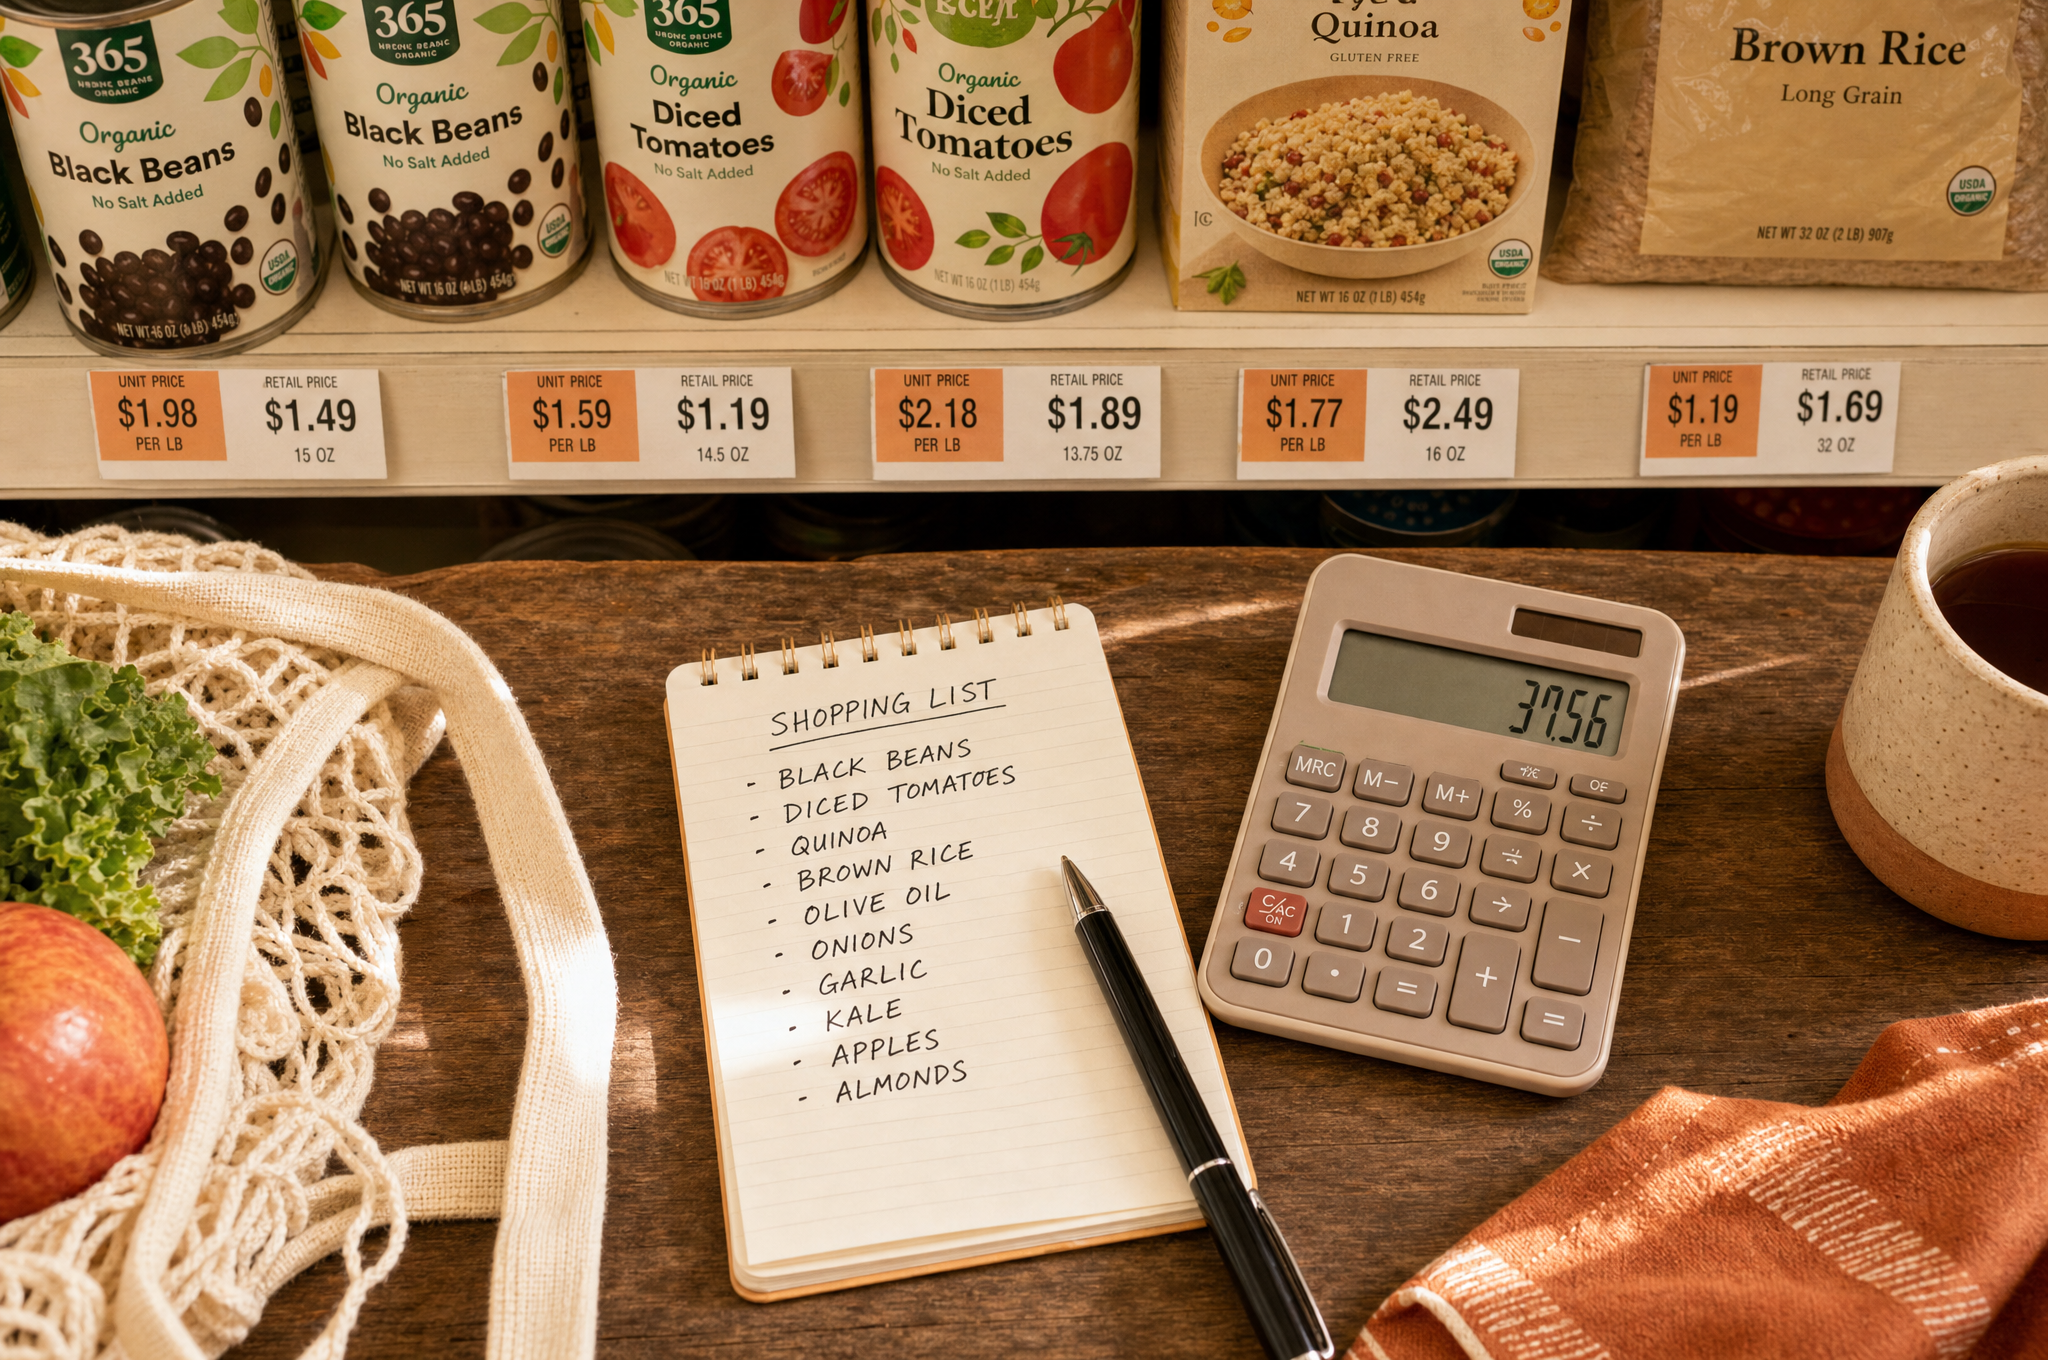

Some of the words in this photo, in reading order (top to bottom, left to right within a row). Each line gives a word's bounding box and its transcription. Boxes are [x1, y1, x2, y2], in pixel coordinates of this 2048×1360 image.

[374, 1, 446, 38] 365
[653, 0, 721, 28] 365
[1311, 12, 1439, 44] Quinoa
[70, 35, 148, 76] 365
[395, 50, 437, 60] ORGANIC
[1330, 53, 1382, 62] GLUTEN
[1387, 53, 1420, 62] FREE
[1730, 27, 1867, 65] Brown
[1879, 30, 1967, 66] Rice
[650, 64, 738, 97] Organic
[938, 62, 1021, 94] Organic
[94, 87, 139, 97] ORGANIC
[376, 82, 469, 114] Organic
[1780, 84, 1836, 108] Long
[1843, 85, 1903, 105] Grain
[653, 99, 741, 128] Diced
[926, 87, 1032, 126] Diced
[344, 110, 424, 145] Black
[432, 105, 523, 144] Beans
[895, 107, 1073, 160] Tomatoes
[79, 121, 176, 153] Organic
[630, 122, 774, 159] Tomatoes
[48, 150, 134, 185] Black
[140, 141, 235, 183] Beans
[383, 154, 404, 168] No
[408, 155, 437, 169] Salt
[441, 146, 490, 168] Added
[654, 162, 673, 177] No
[676, 166, 703, 180] Salt
[707, 164, 754, 180] Added
[932, 162, 950, 177] No
[954, 166, 980, 181] Salt
[984, 168, 1031, 181] Added
[1959, 178, 1986, 190] USDA
[92, 195, 114, 209] No
[118, 195, 148, 210] Salt
[152, 184, 204, 207] Added
[1757, 226, 1777, 240] NET
[1780, 226, 1797, 240] WT
[1799, 226, 1814, 241] 32
[1816, 227, 1830, 241] OZ
[1833, 227, 1846, 242] (2
[1848, 227, 1865, 243] LB)
[1868, 228, 1894, 244] 907g
[1499, 248, 1523, 257] USDA
[400, 279, 416, 294] NET
[664, 270, 680, 285] NET
[935, 268, 948, 283] NET
[950, 272, 963, 287] WT
[966, 274, 975, 289] 16
[977, 275, 988, 290] OZ
[989, 276, 999, 292] (1
[1000, 277, 1014, 292] LB)
[1019, 277, 1040, 292] 454g
[1296, 290, 1315, 303] NET
[1319, 291, 1335, 303] WT
[1338, 291, 1349, 303] 16
[1353, 291, 1366, 303] OZ
[1369, 291, 1377, 304] (1
[1379, 291, 1397, 304] LB)
[1400, 291, 1426, 305] 454g
[116, 322, 134, 337] NET
[118, 375, 146, 388] UNIT
[152, 375, 185, 388] PRICE
[265, 376, 302, 388] RETAIL
[306, 376, 338, 388] PRICE
[537, 376, 565, 388] UNIT
[570, 375, 602, 388] PRICE
[681, 375, 718, 387] RETAIL
[722, 374, 754, 386] PRICE
[904, 374, 932, 386] UNIT
[937, 374, 970, 386] PRICE
[1050, 374, 1088, 386] RETAIL
[1092, 374, 1124, 386] PRICE
[1271, 374, 1298, 387] UNIT
[1302, 374, 1335, 387] PRICE
[1409, 374, 1446, 386] RETAIL
[1450, 374, 1482, 386] PRICE
[1673, 370, 1699, 384] UNIT
[1702, 370, 1733, 384] PRICE
[1802, 368, 1838, 381] RETAIL
[1841, 368, 1872, 380] PRICE
[118, 396, 197, 432] $1.98
[265, 397, 356, 434] $1.49
[533, 396, 612, 432] $1.59
[678, 396, 770, 433] $1.19
[898, 396, 978, 432] $2.18
[1048, 394, 1142, 433] $1.89
[1266, 395, 1343, 432] $1.77
[1402, 395, 1494, 434] $2.49
[1668, 392, 1738, 428] $1.19
[1798, 388, 1884, 426] $1.69
[136, 437, 161, 451] PER
[166, 437, 183, 451] LB
[549, 438, 574, 452] PER
[580, 438, 596, 452] LB
[914, 438, 938, 452] PER
[945, 438, 961, 452] LB
[1280, 437, 1304, 452] PER
[1310, 437, 1326, 452] LB
[1680, 434, 1702, 448] PER
[1706, 434, 1722, 448] LB
[1817, 438, 1832, 453] 32
[1836, 438, 1856, 453] OZ
[294, 448, 311, 462] 15
[316, 448, 335, 462] OZ
[697, 447, 725, 462] 14.5
[730, 447, 750, 462] OZ
[1063, 446, 1099, 461] 13.75
[1104, 446, 1123, 461] OZ
[1425, 446, 1442, 462] 16
[1446, 446, 1466, 462] OZ
[771, 692, 911, 736] SHOPPING
[929, 678, 997, 709] LIST
[1508, 679, 1612, 748] 37.56
[779, 757, 866, 789] BLACK
[887, 738, 971, 770] BEANS
[1295, 756, 1336, 778] MRC
[784, 792, 869, 823] DICED
[888, 765, 1016, 803] TOMATOES
[1435, 784, 1470, 802] M+
[1294, 802, 1312, 822] 7
[791, 821, 887, 856] QUINOA
[1362, 817, 1380, 838] 8
[1434, 831, 1451, 852] 9
[797, 855, 891, 891] BROWN
[911, 841, 974, 870] RICE
[1279, 851, 1297, 872] 4
[1350, 864, 1368, 886] 5
[1421, 880, 1438, 900] 6
[804, 892, 886, 925] OLIVE
[905, 882, 951, 905] OIL
[1265, 914, 1283, 926] ON
[1342, 913, 1352, 934] 1
[811, 923, 913, 960] ONIONS
[1408, 928, 1427, 950] 2
[1254, 948, 1273, 970] 0
[819, 960, 928, 995] GARLIC
[826, 999, 902, 1032] KALE
[832, 1029, 939, 1067] APPLES
[836, 1060, 967, 1103] ALMONDS
